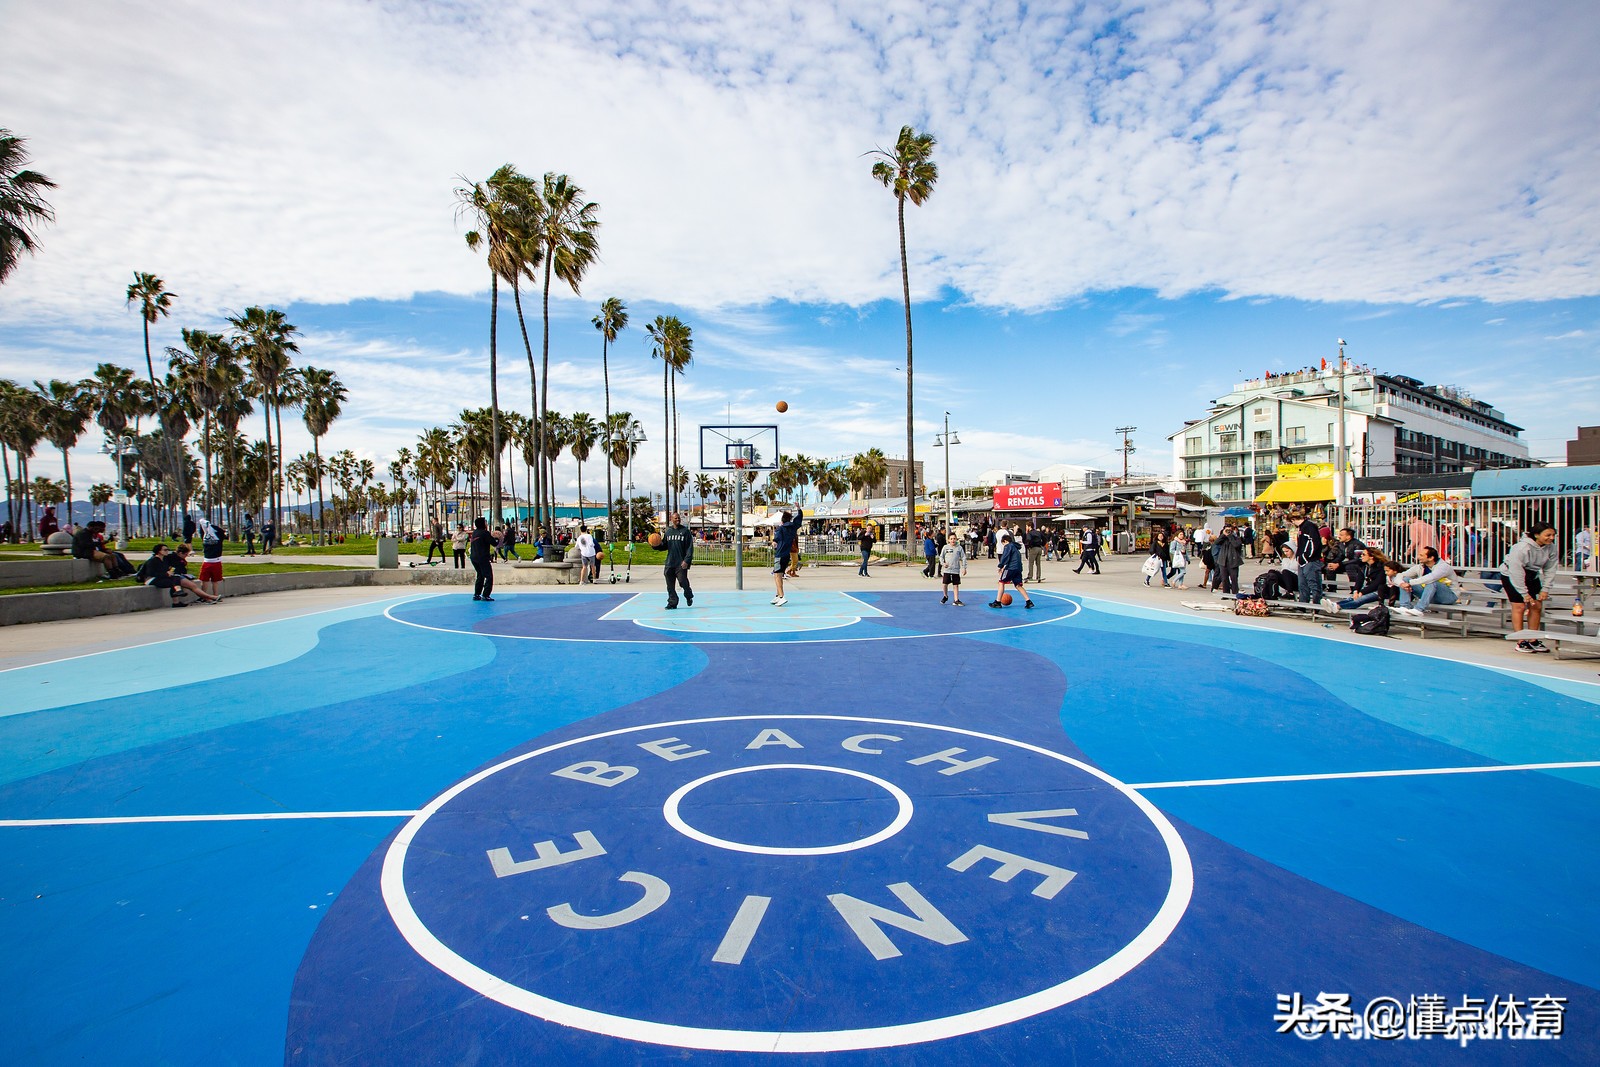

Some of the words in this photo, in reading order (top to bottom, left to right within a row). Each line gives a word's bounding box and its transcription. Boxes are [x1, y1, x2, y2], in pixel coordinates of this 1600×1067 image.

[1214, 422, 1242, 432] ERWIN
[1009, 486, 1043, 496] BICYCLE
[1520, 484, 1555, 492] Seven
[1007, 496, 1045, 507] RENTALS
[551, 728, 999, 788] BEACH
[487, 808, 1089, 965] VENICE
